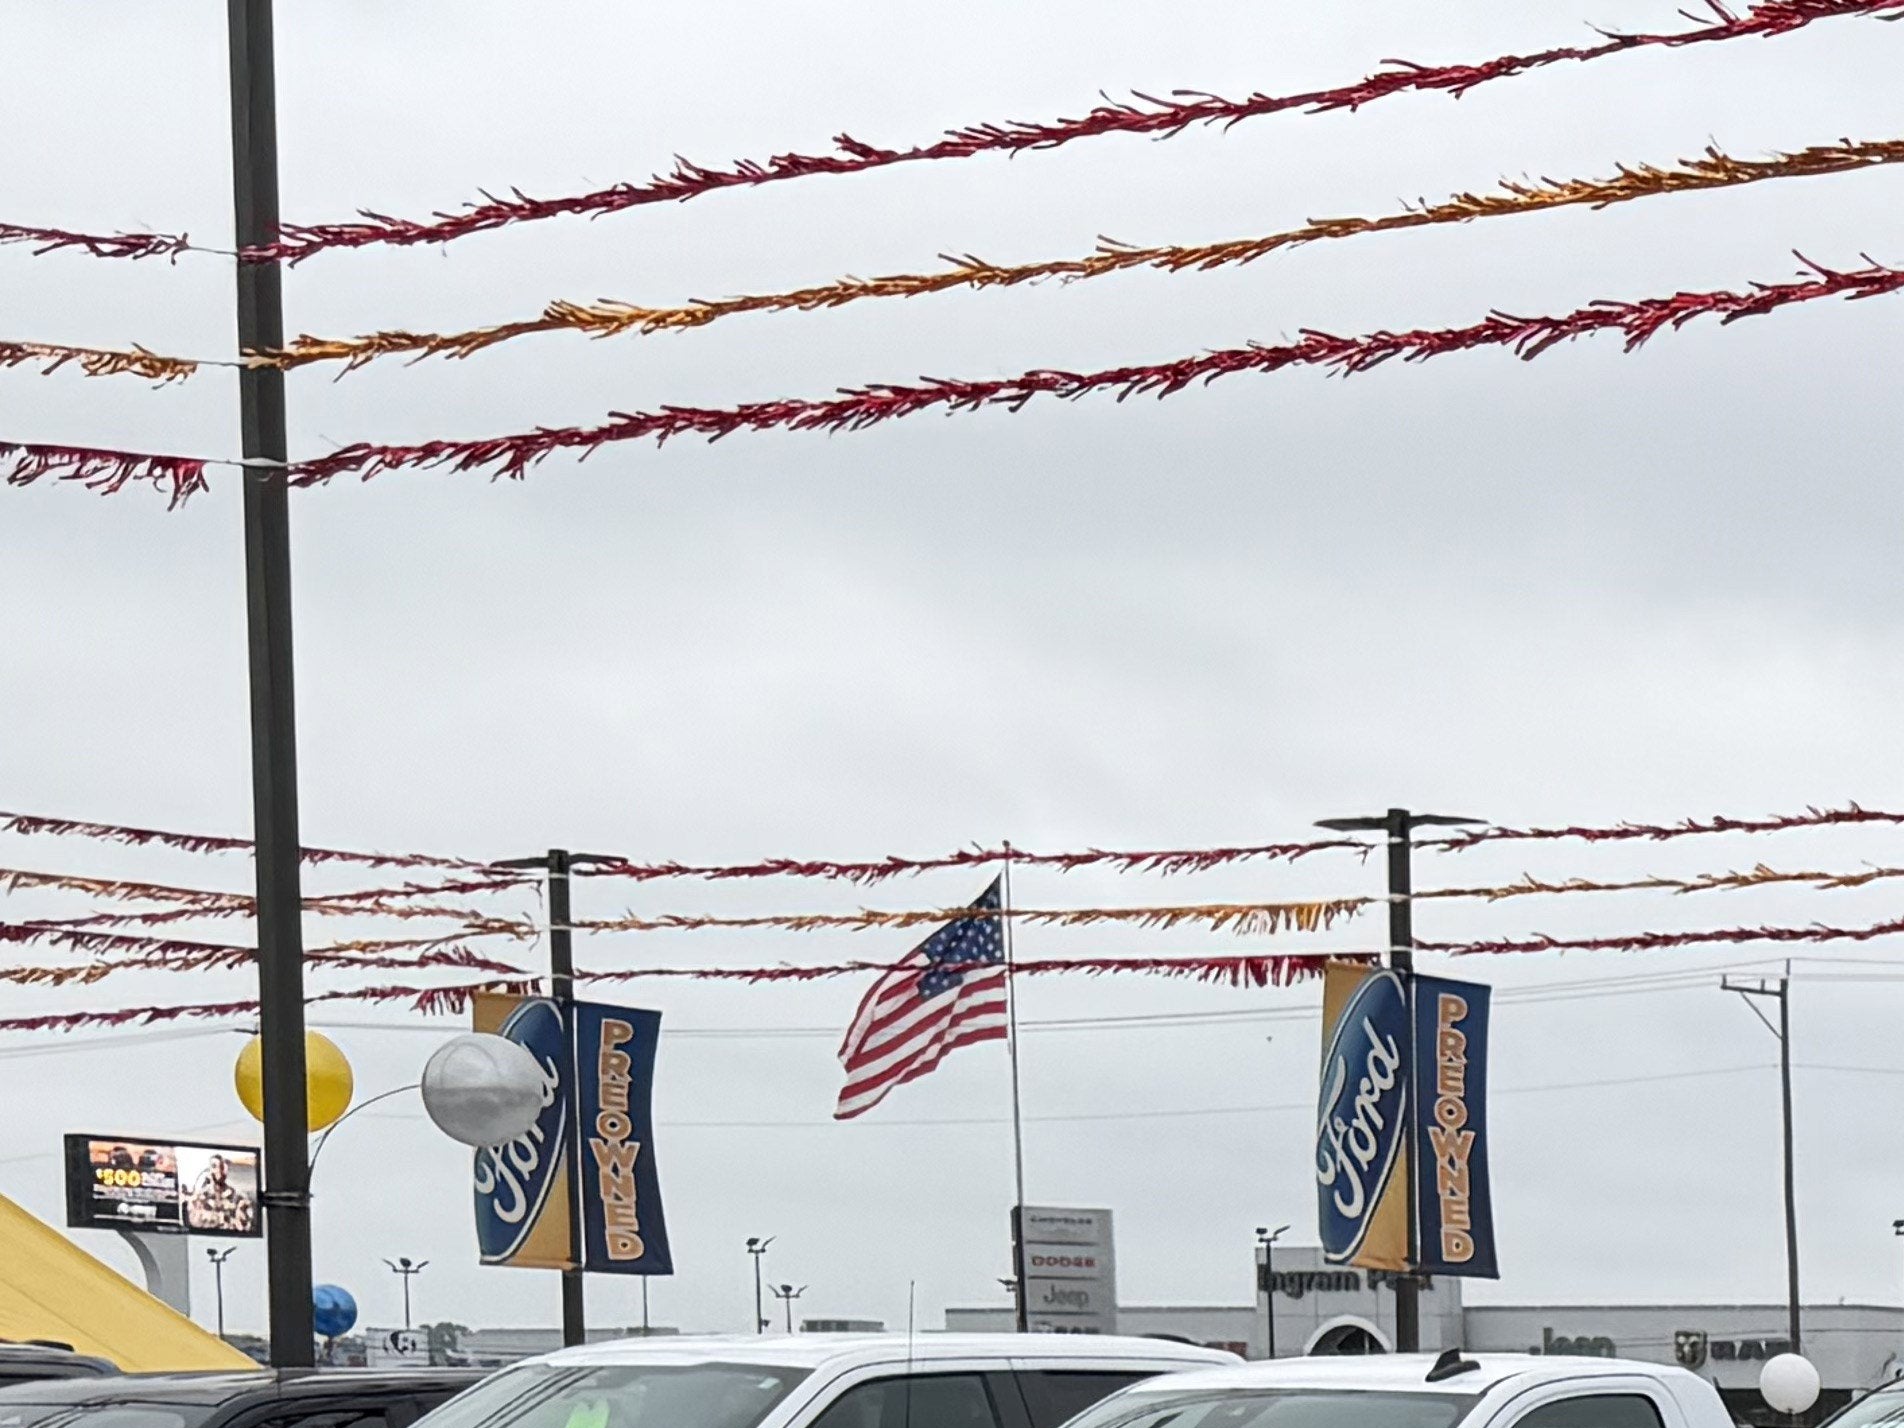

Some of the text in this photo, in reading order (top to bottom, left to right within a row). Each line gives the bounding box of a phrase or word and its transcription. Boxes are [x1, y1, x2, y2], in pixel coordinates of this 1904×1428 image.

[588, 1017, 645, 1261] PREOWNED
[1316, 1015, 1401, 1219] Ford
[1427, 992, 1476, 1263] PREOWNED
